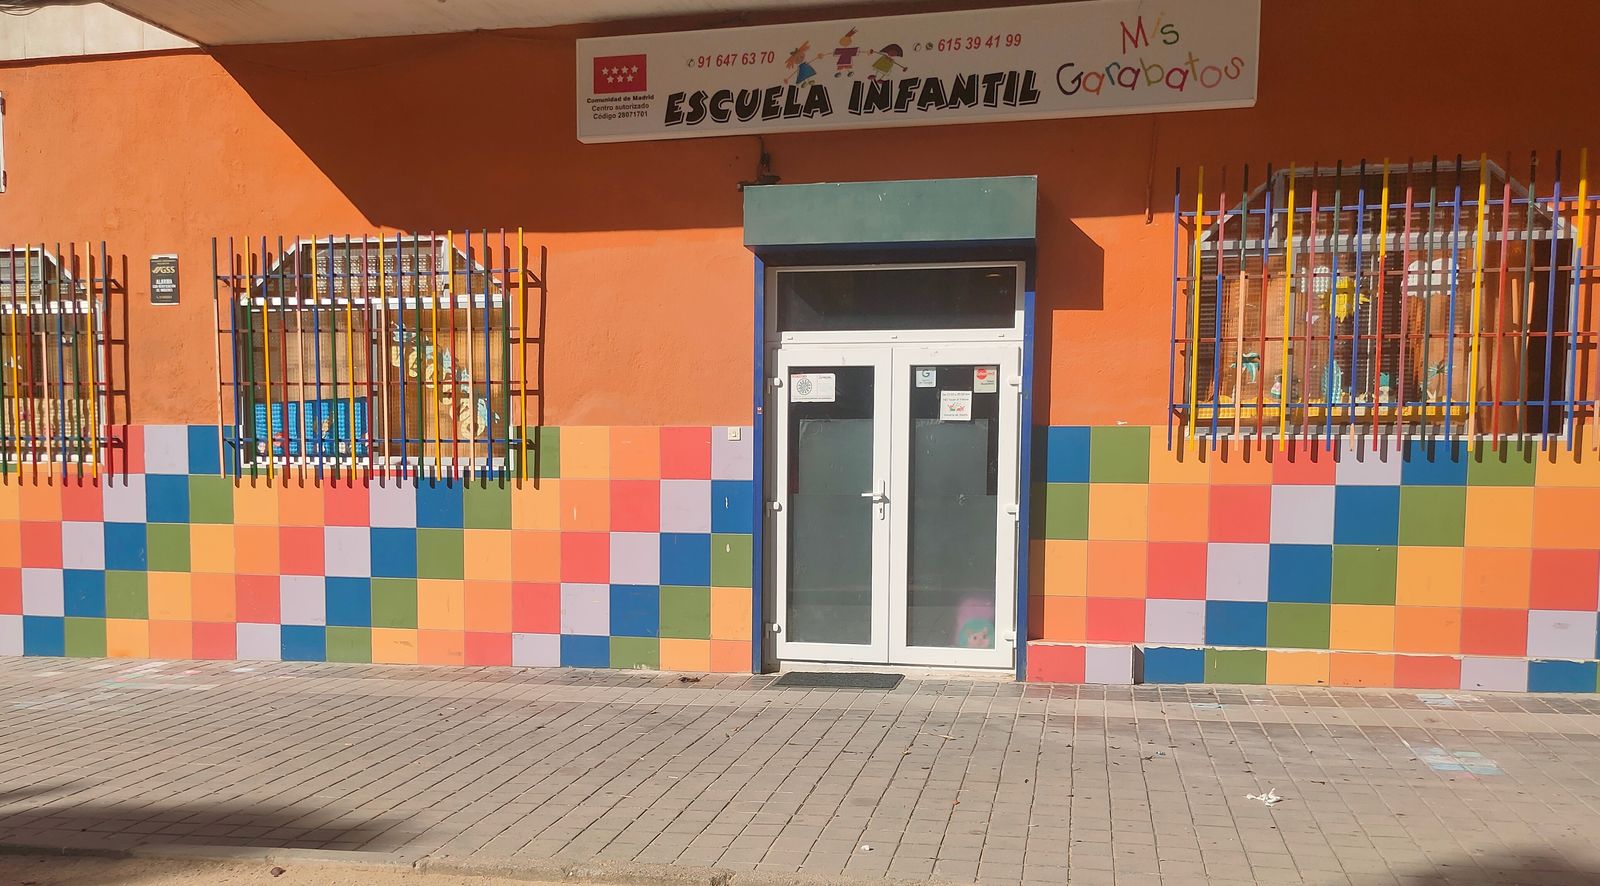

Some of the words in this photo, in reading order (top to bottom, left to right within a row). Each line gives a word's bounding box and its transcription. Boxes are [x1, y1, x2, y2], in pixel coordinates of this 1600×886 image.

[938, 38, 962, 52] 615
[965, 36, 982, 50] 39
[985, 34, 1001, 48] 41
[1005, 33, 1022, 47] 99
[1120, 11, 1180, 55] Mis
[697, 55, 711, 68] 91
[716, 53, 738, 67] 647
[741, 52, 757, 66] 63
[760, 51, 775, 64] 70
[1056, 52, 1245, 96] Garabatos
[586, 96, 622, 104] Comunidad
[664, 83, 833, 127] ESCUELA
[848, 69, 1042, 116] INFANTIL
[618, 110, 648, 119] 28071701
